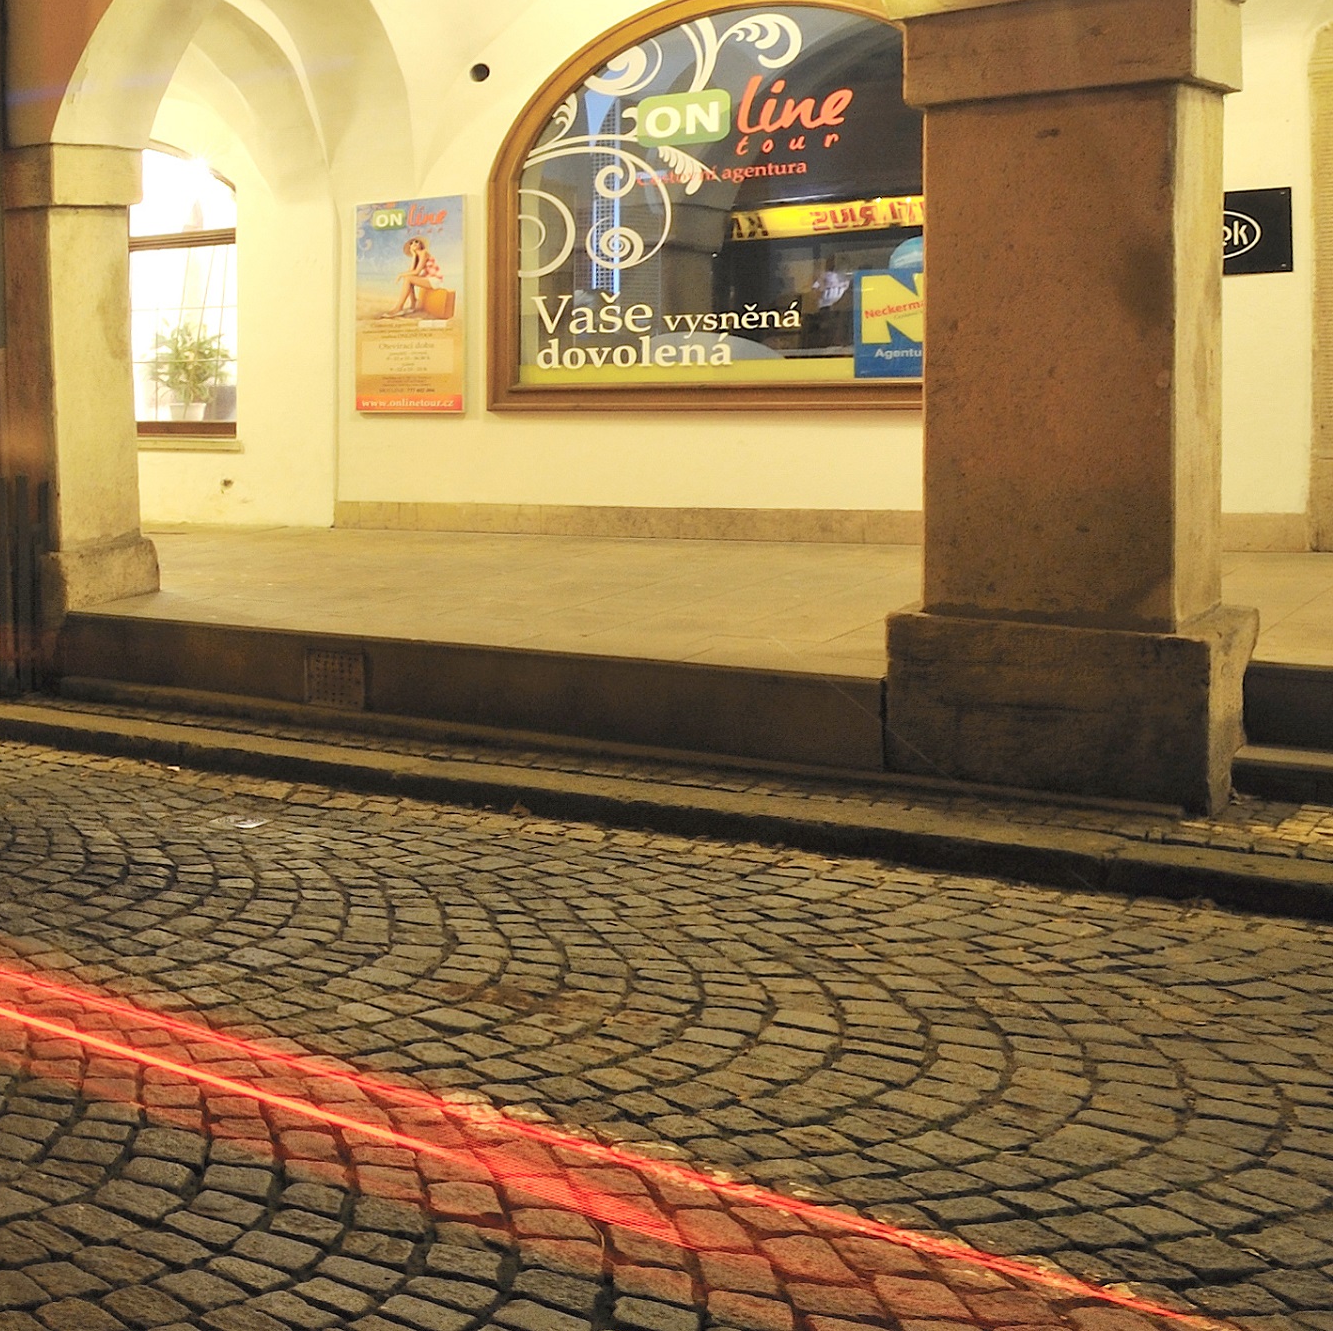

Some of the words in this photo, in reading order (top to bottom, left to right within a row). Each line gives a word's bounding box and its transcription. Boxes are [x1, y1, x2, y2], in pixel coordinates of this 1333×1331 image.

[645, 101, 720, 139] ON
[737, 75, 854, 135] line
[736, 132, 840, 157] tour
[722, 162, 808, 183] agentura
[375, 213, 403, 228] ON
[408, 204, 448, 227] line
[531, 291, 654, 334] Vaše
[662, 301, 802, 339] vysněná
[536, 333, 733, 369] dovolená
[361, 397, 455, 408] www.onlinetour.cz
